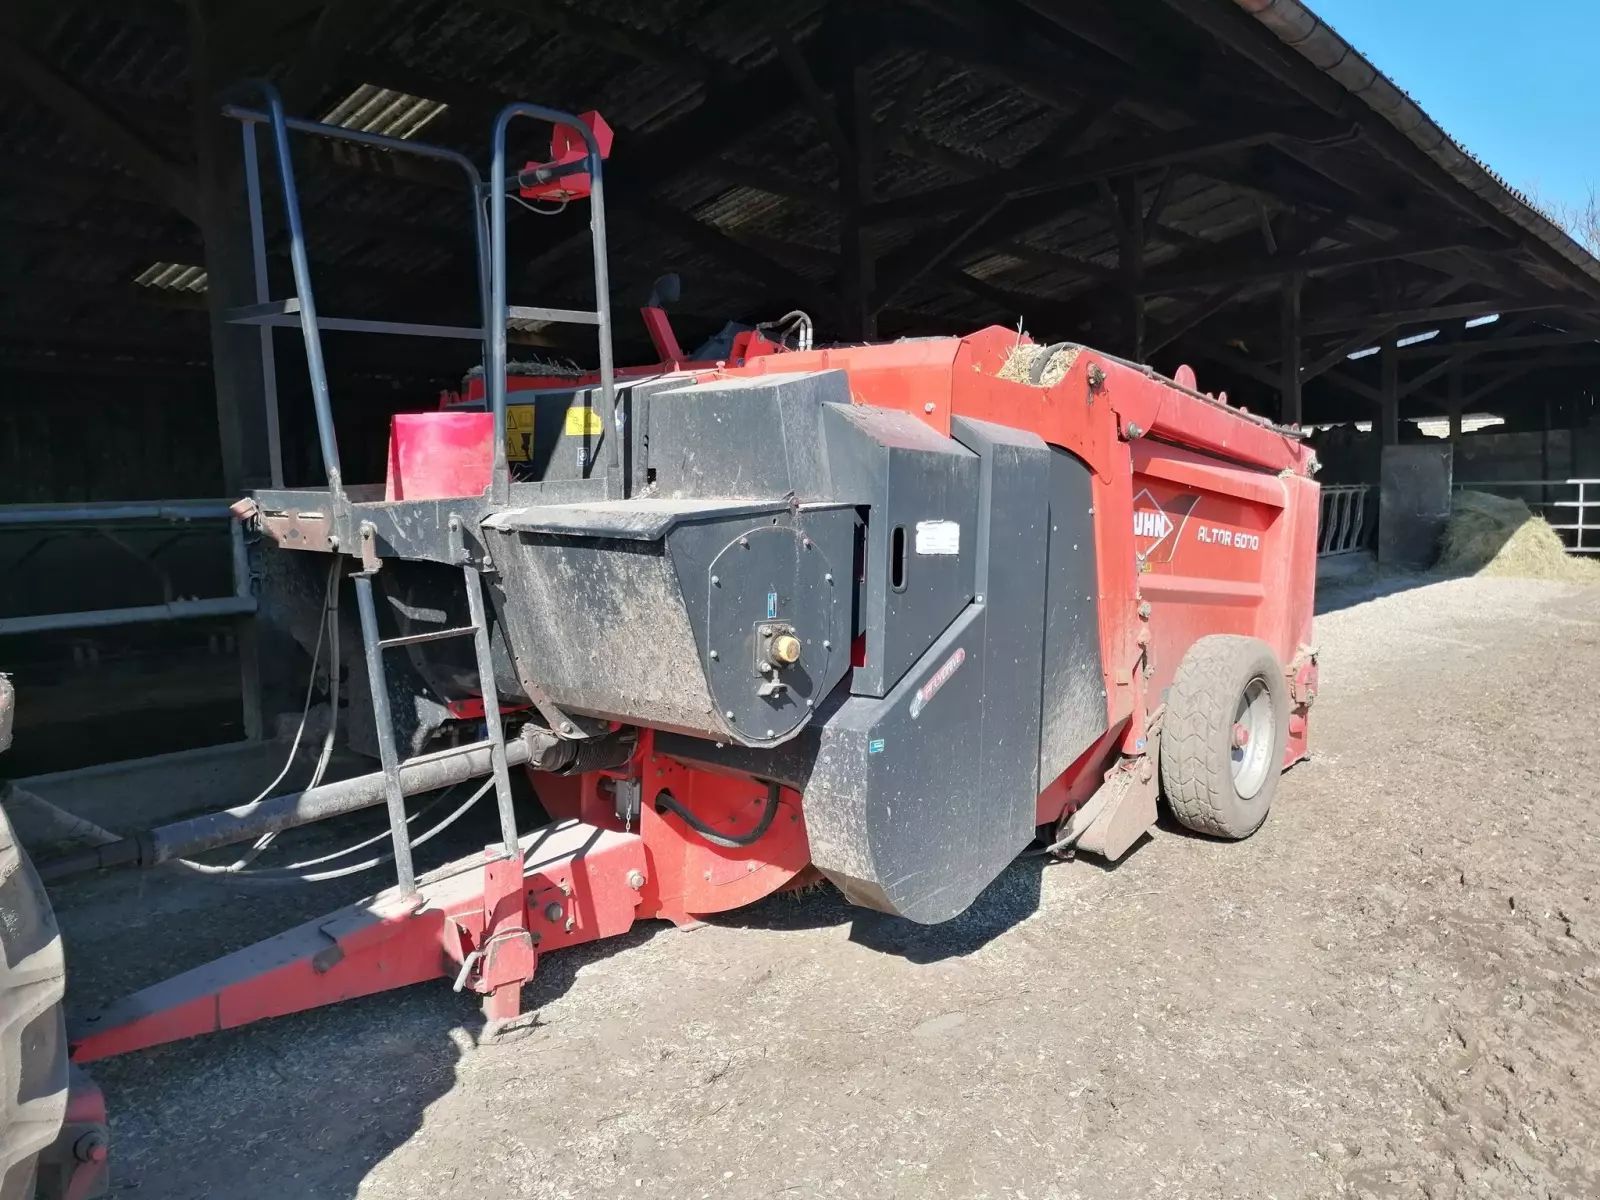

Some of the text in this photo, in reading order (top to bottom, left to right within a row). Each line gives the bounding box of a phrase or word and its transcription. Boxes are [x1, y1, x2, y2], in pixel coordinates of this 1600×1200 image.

[1133, 511, 1165, 538] UHN
[1197, 525, 1260, 551] ALTOR 6070
